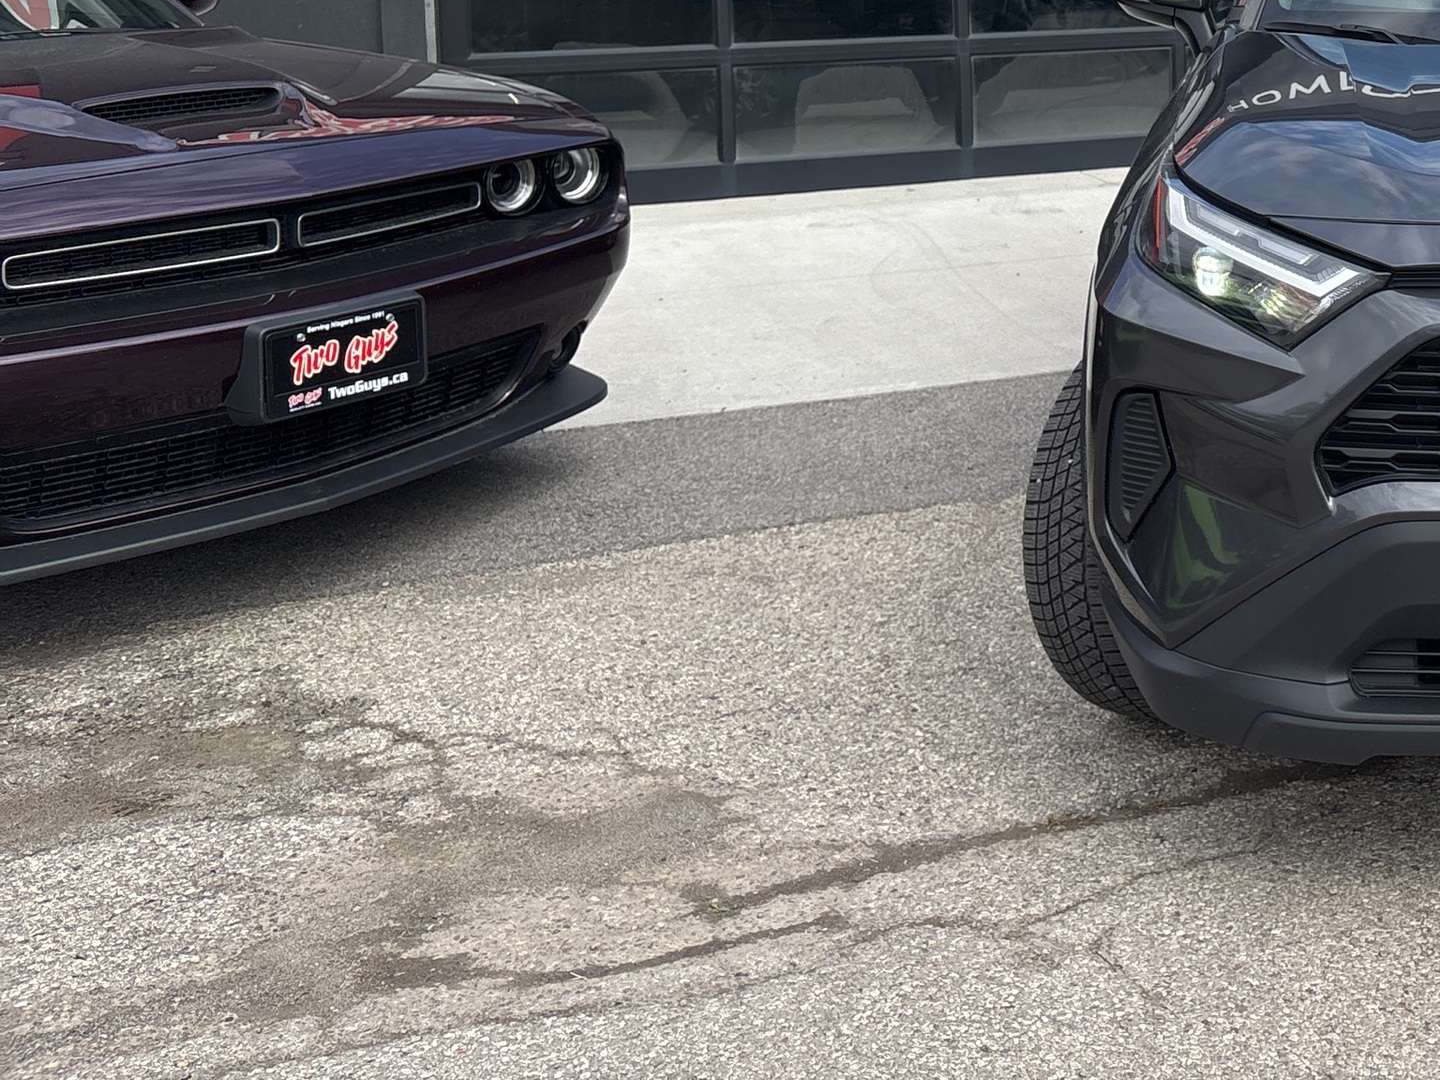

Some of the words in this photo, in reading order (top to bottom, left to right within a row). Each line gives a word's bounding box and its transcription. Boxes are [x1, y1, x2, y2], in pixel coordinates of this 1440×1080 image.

[307, 323, 330, 333] Serving
[290, 339, 340, 386] Two
[344, 321, 398, 373] Guys
[327, 372, 409, 400] TwoGuys.ca
